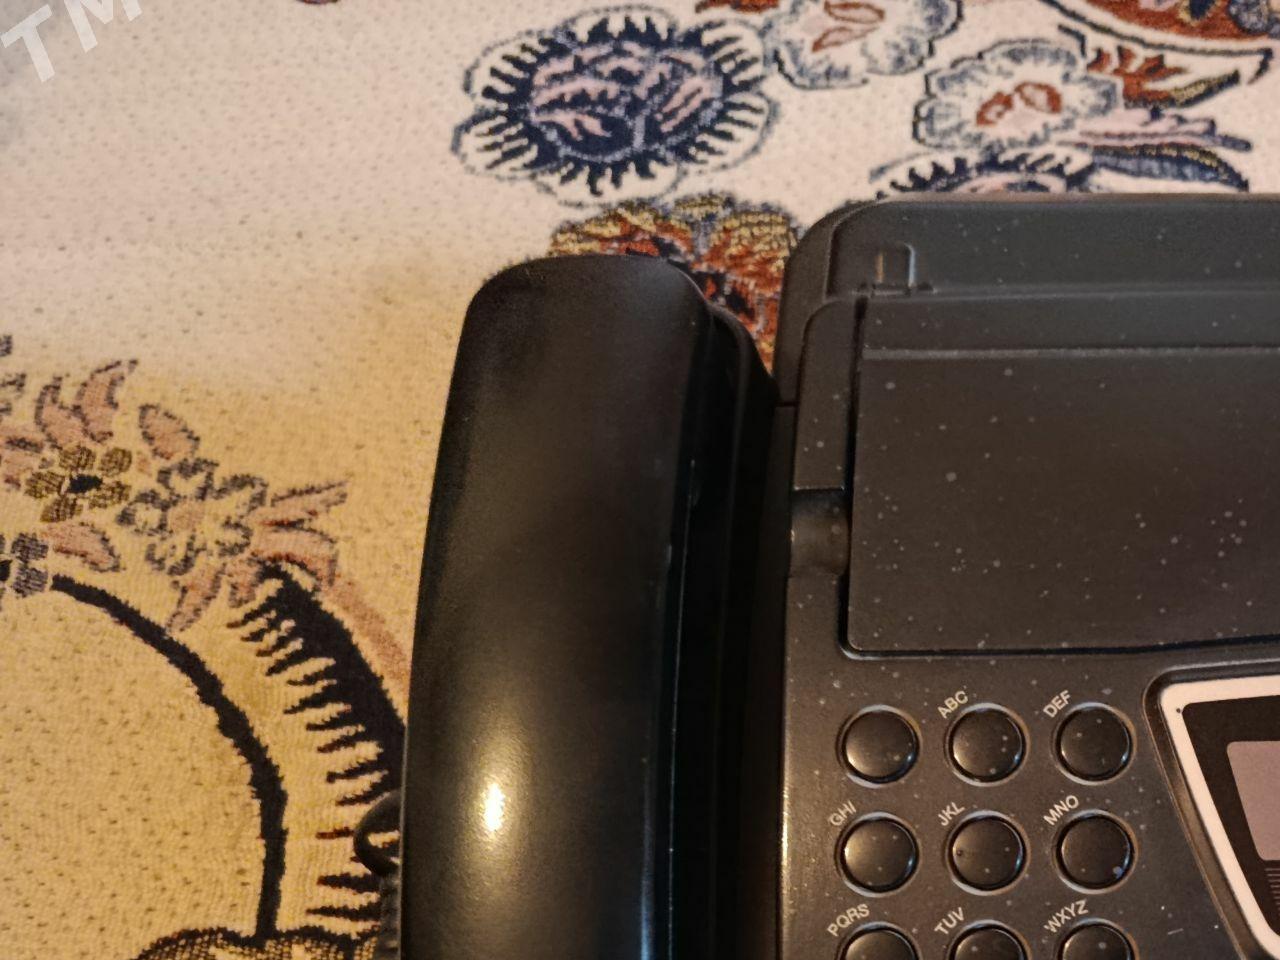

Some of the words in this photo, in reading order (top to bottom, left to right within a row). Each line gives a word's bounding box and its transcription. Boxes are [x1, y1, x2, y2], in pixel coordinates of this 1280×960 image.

[937, 690, 969, 720] ABC
[1043, 690, 1073, 719] DEF
[830, 800, 857, 829] GHI
[936, 802, 966, 829] JKL
[1043, 795, 1080, 828] MNO
[827, 903, 871, 938] PQRS
[934, 907, 966, 936] TUV
[1043, 900, 1089, 935] WXYZ
